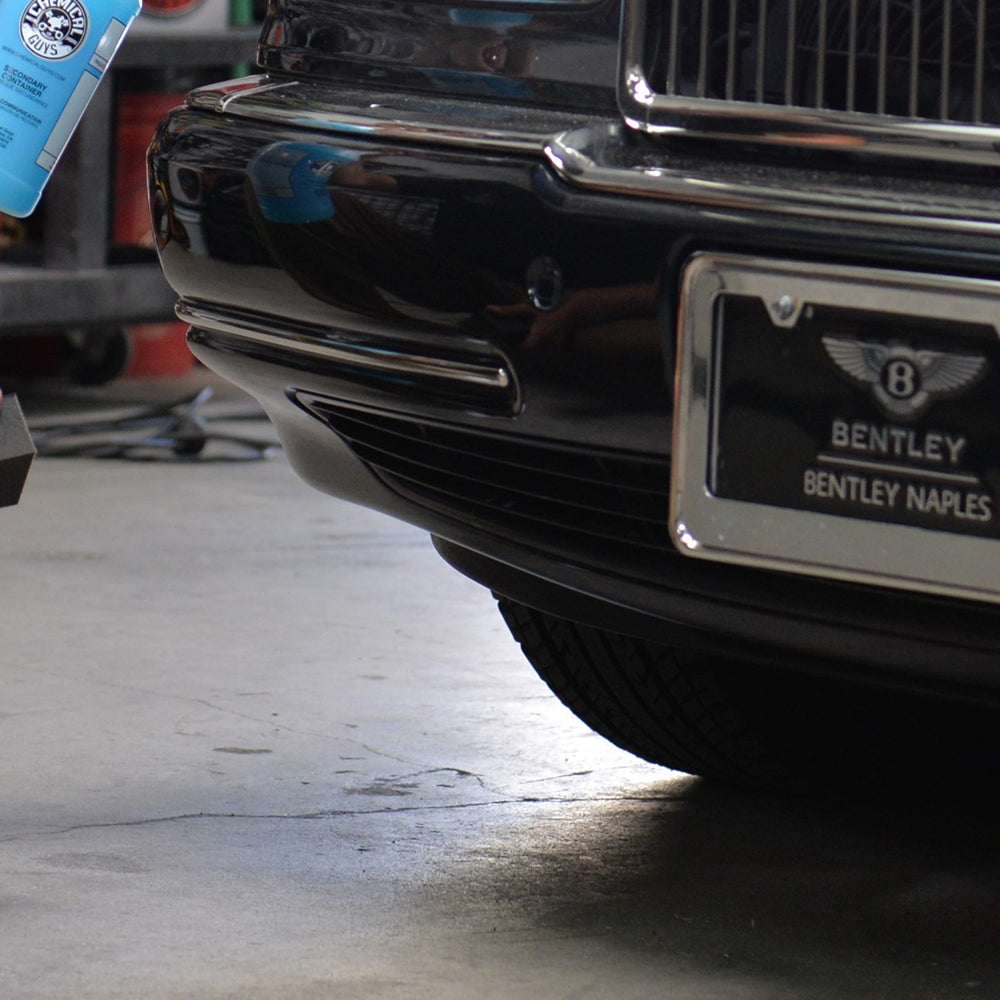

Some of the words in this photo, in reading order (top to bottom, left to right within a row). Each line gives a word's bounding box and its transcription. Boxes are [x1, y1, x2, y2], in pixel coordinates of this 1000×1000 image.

[28, 34, 58, 56] GUYS
[1, 72, 43, 97] CONTAINER
[831, 420, 967, 462] BENTLEY
[803, 469, 900, 507] BENTLEY
[906, 485, 992, 522] NAPLES
